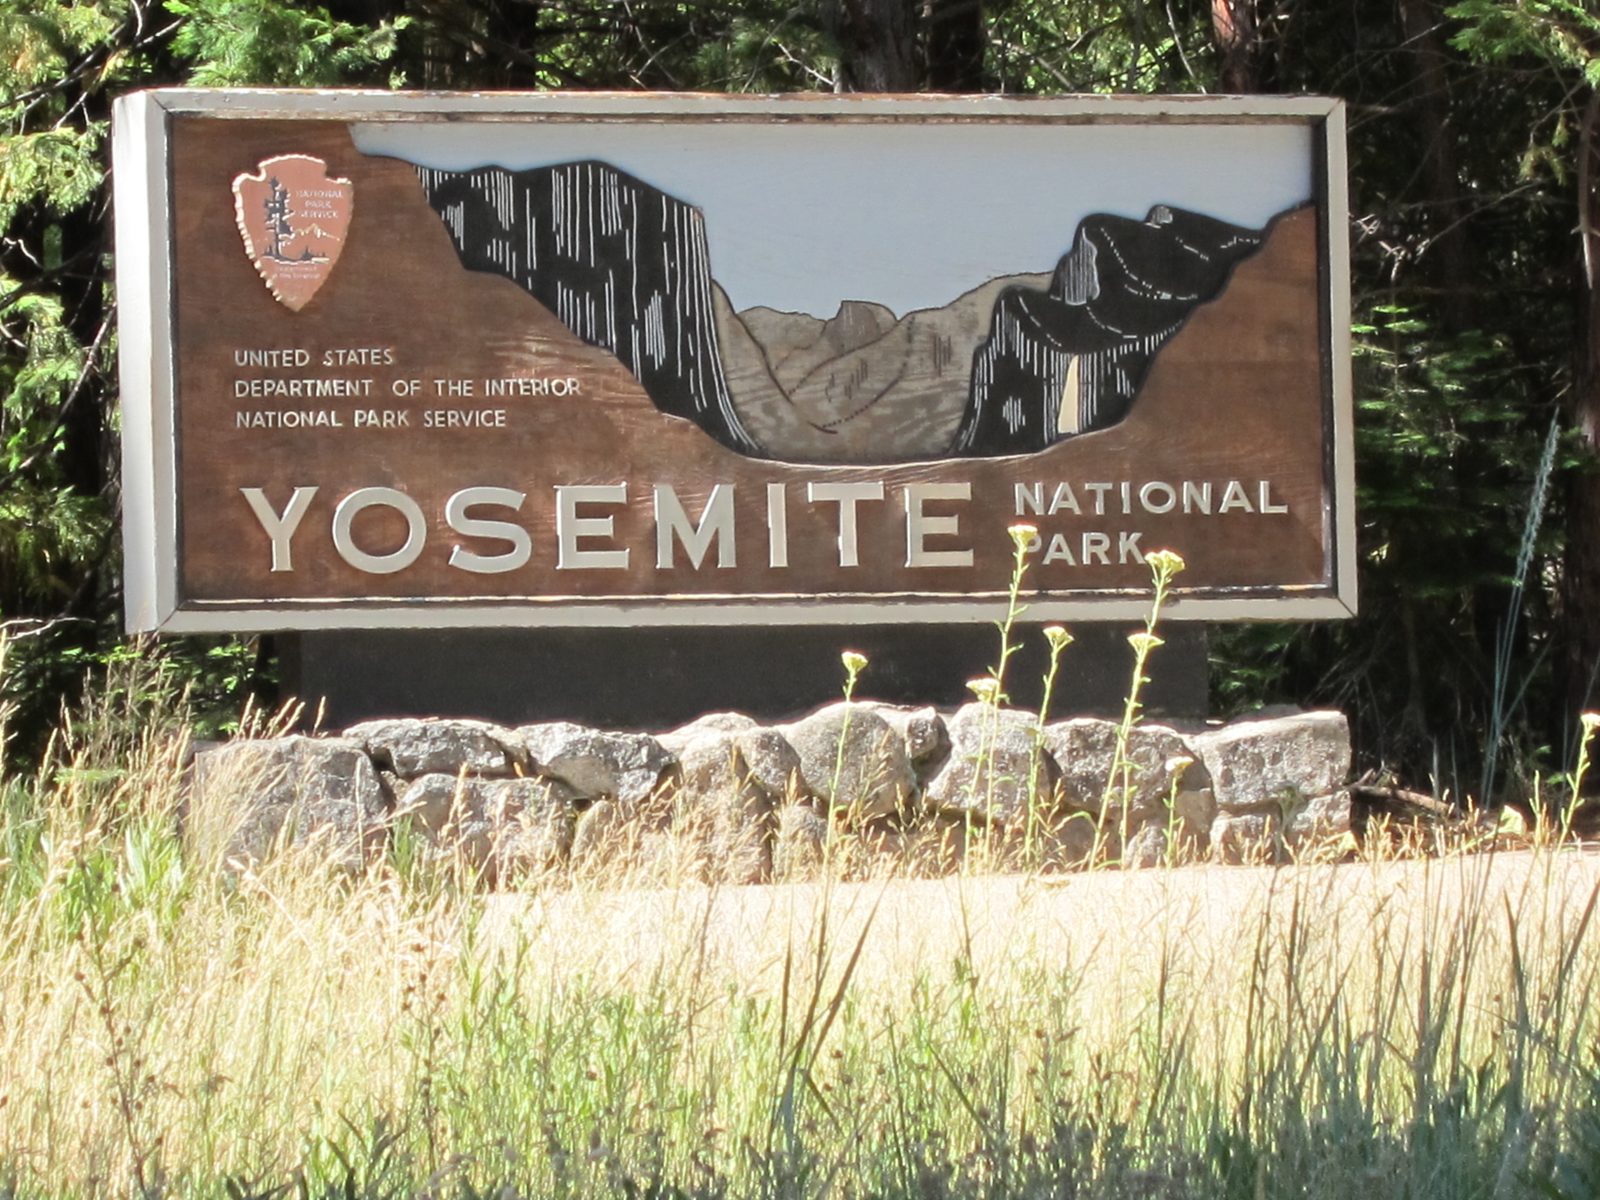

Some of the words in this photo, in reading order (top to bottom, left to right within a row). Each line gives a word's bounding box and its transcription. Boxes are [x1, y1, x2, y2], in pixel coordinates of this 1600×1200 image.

[234, 349, 310, 367] UNITED
[322, 348, 394, 367] STATES
[234, 379, 374, 398] DEPARTMENT
[391, 379, 422, 397] OF
[433, 379, 474, 397] THE
[484, 377, 582, 397] INTERIOR
[235, 409, 343, 429] NATIONAL
[353, 409, 410, 428] PARK
[423, 409, 507, 428] SERVICE
[240, 481, 976, 574] YOSEMITE
[1014, 480, 1289, 517] NATIONAL
